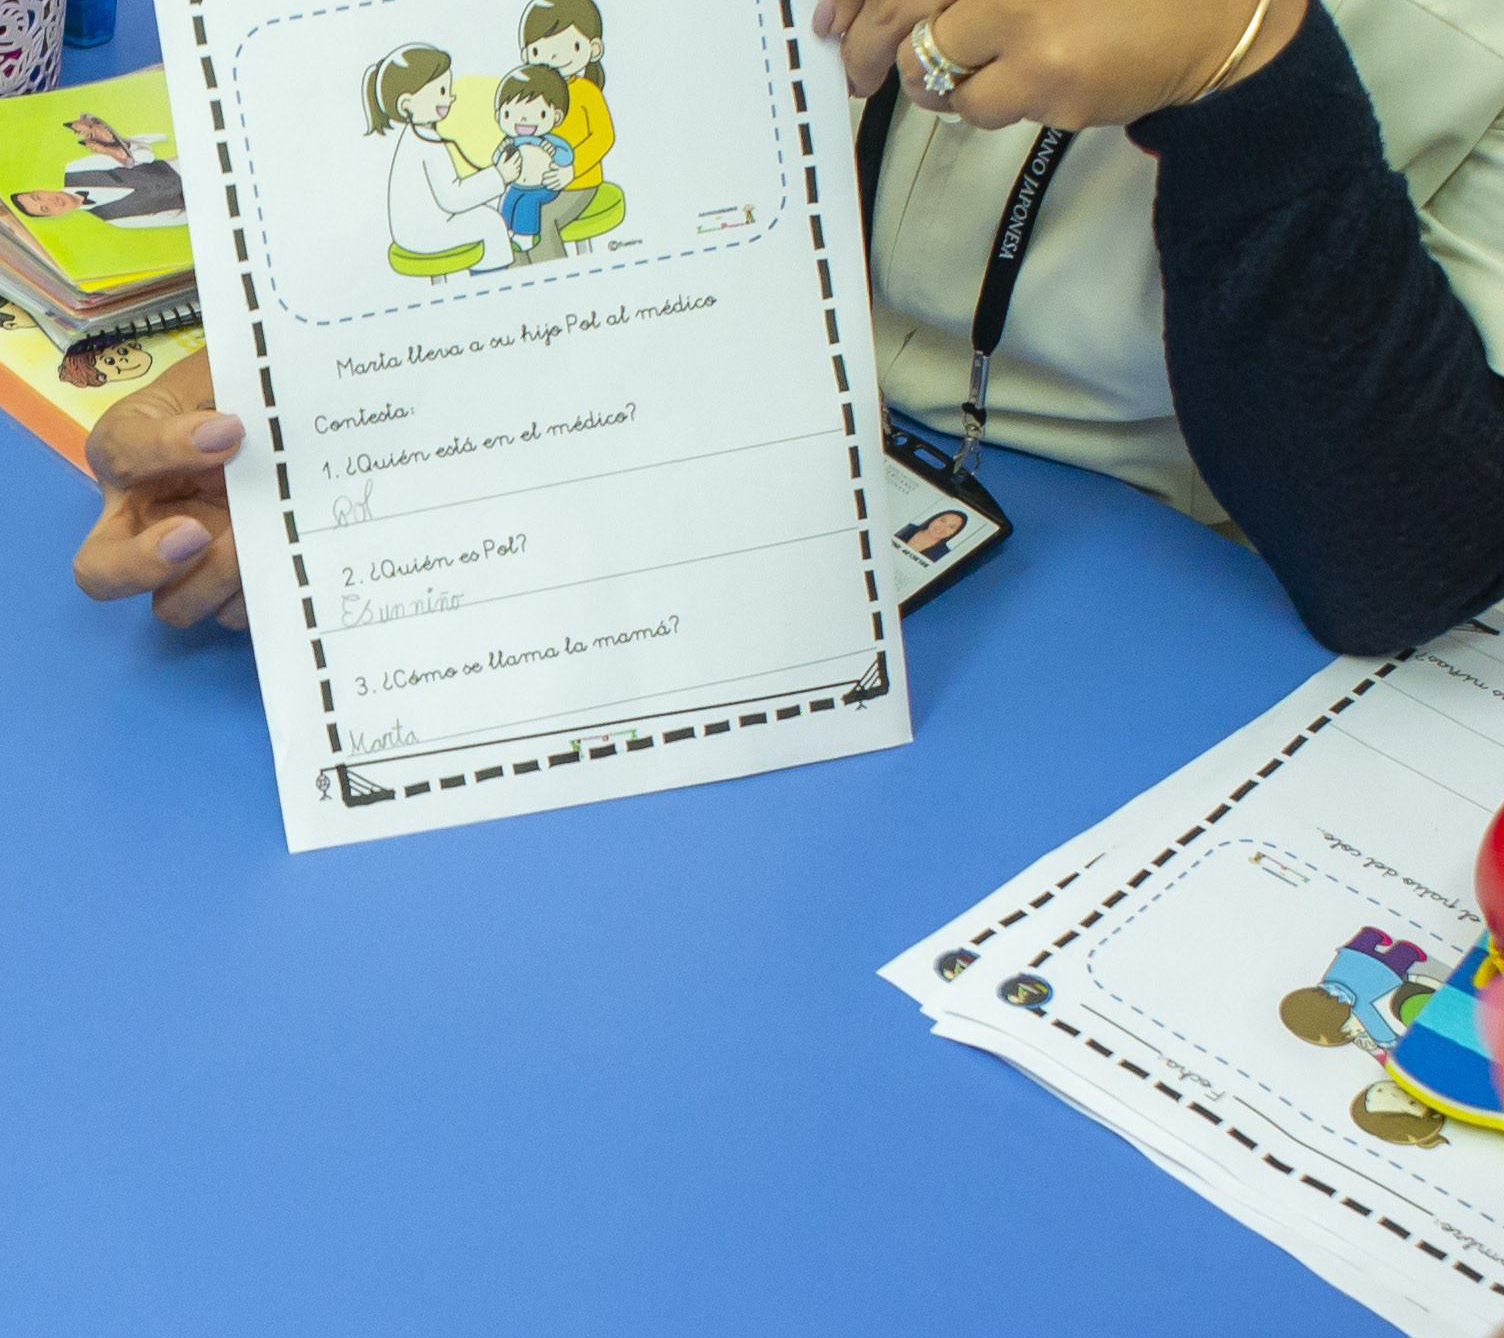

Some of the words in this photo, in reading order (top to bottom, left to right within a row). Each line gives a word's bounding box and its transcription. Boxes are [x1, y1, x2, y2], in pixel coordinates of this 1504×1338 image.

[998, 173, 1040, 260] JAPONESA
[336, 352, 403, 379] Marta
[407, 345, 465, 365] lleva
[469, 340, 485, 354] a
[489, 334, 515, 348] su
[520, 322, 563, 346] hijo
[565, 310, 601, 334] Pol
[605, 304, 630, 326] al
[635, 294, 718, 321] médico
[314, 402, 416, 435] Contesta:
[322, 460, 340, 480] 1.
[346, 448, 431, 476] ¿Quién
[434, 436, 478, 459] está
[482, 433, 516, 449] en
[519, 421, 542, 442] el
[546, 401, 637, 437] médico?
[342, 566, 365, 588] 2.
[370, 554, 454, 582] ¿Quién
[458, 550, 481, 565] es
[482, 533, 528, 560] Pol?
[354, 675, 377, 697] 3.
[382, 665, 459, 692] ¿Cómo
[462, 660, 484, 676] se
[488, 647, 560, 671] llama
[564, 636, 589, 656] la
[592, 614, 681, 649] mamá?
